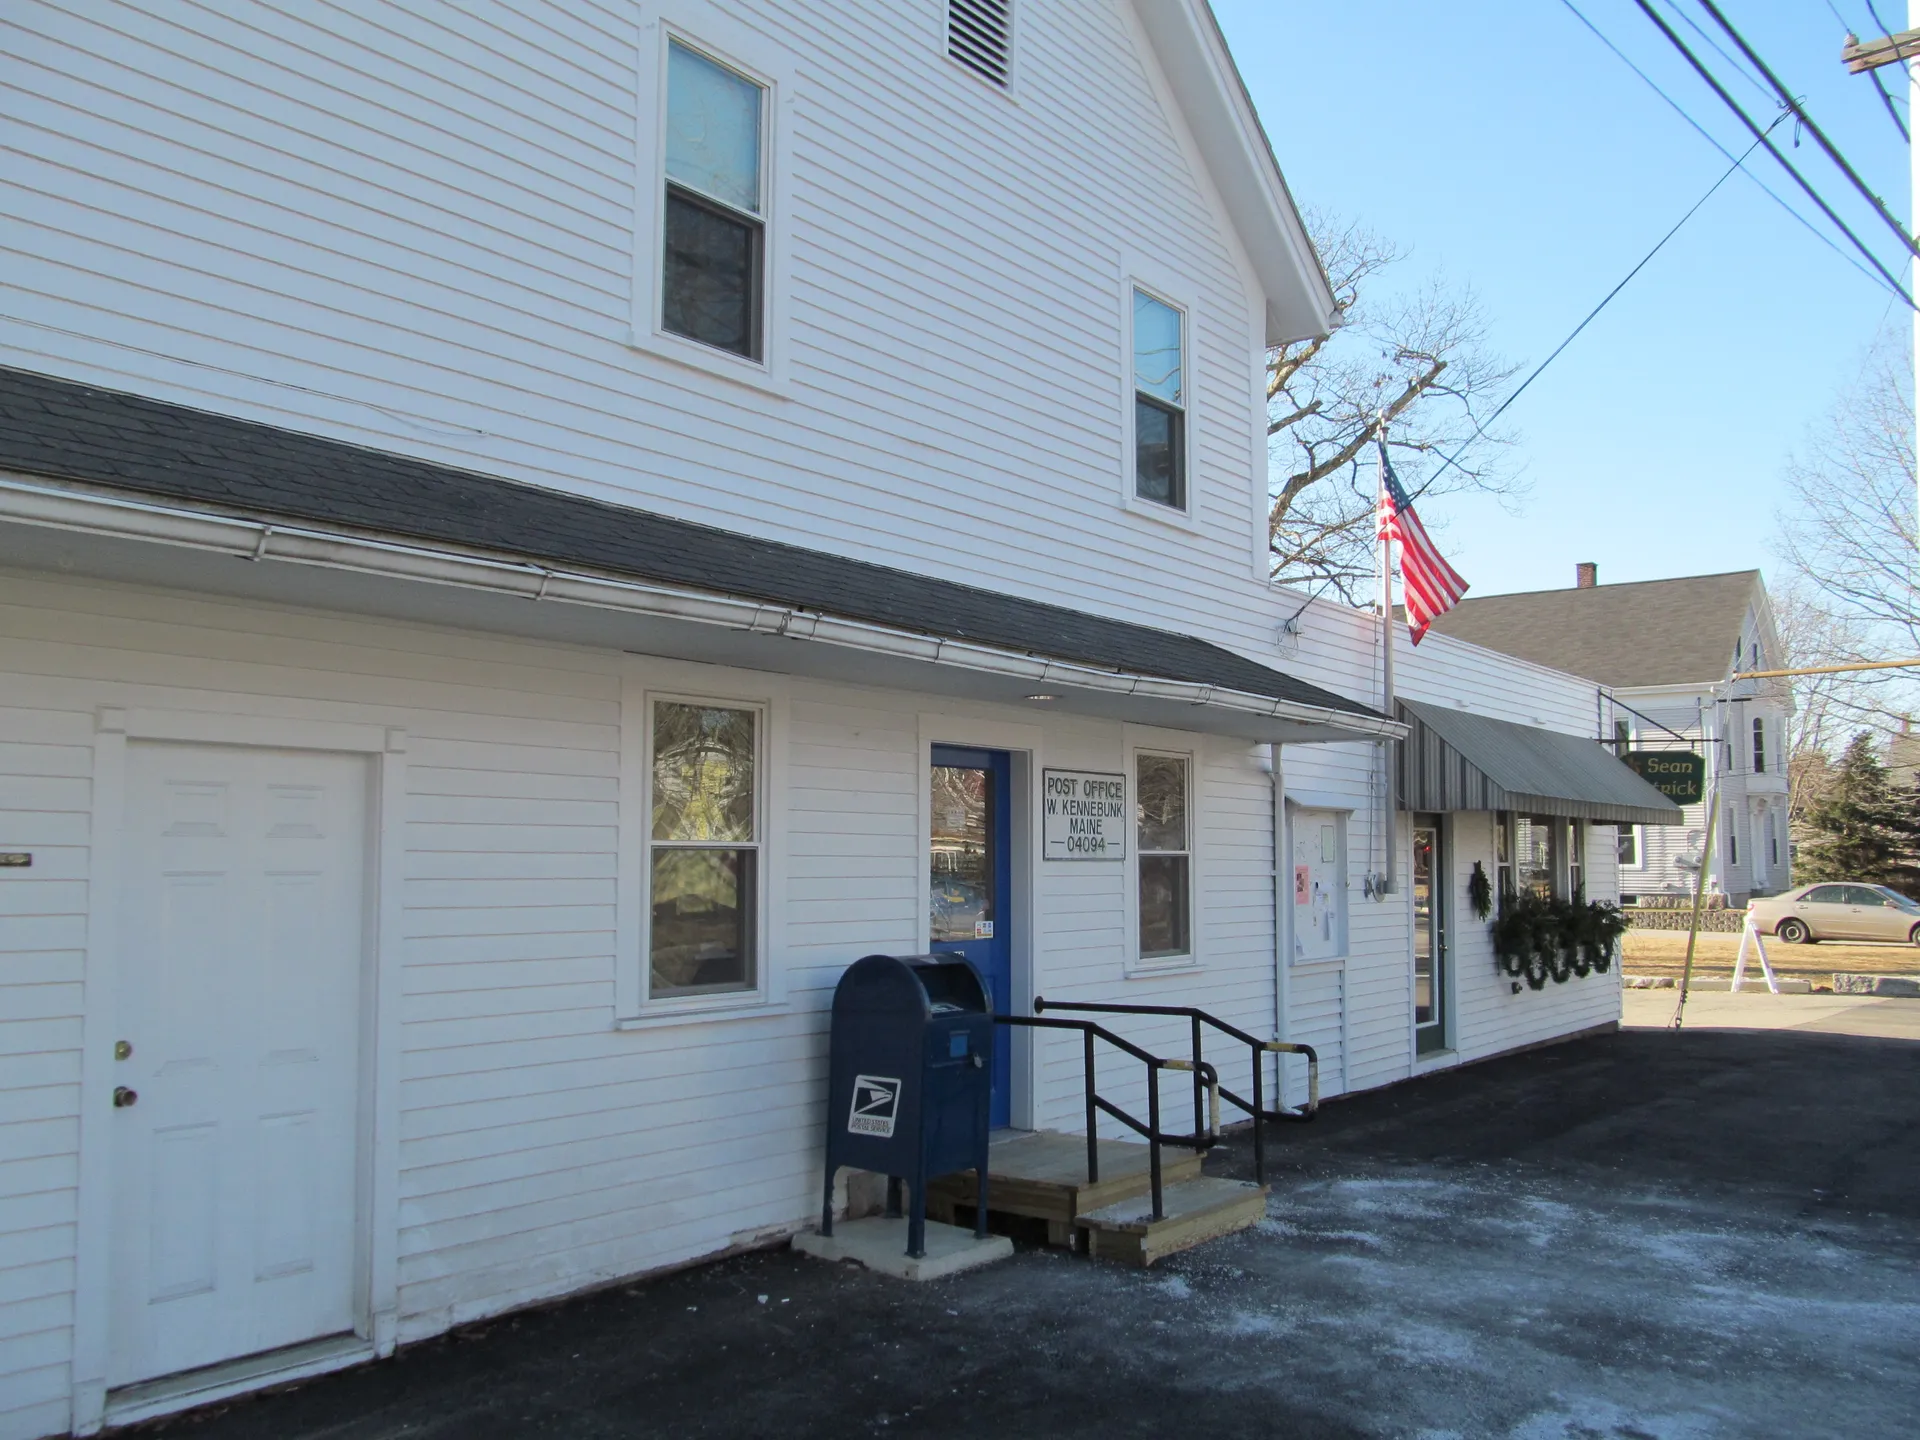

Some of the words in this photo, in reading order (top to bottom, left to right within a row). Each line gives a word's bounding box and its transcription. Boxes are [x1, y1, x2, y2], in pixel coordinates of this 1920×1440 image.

[1648, 758, 1693, 773] Sean
[1047, 777, 1078, 797] POST
[1083, 780, 1123, 799] OFFICE
[1046, 799, 1059, 815] W.
[1062, 799, 1123, 817] KENNEBUNK
[1070, 818, 1102, 835] MAINE
[1067, 836, 1105, 852] 04094
